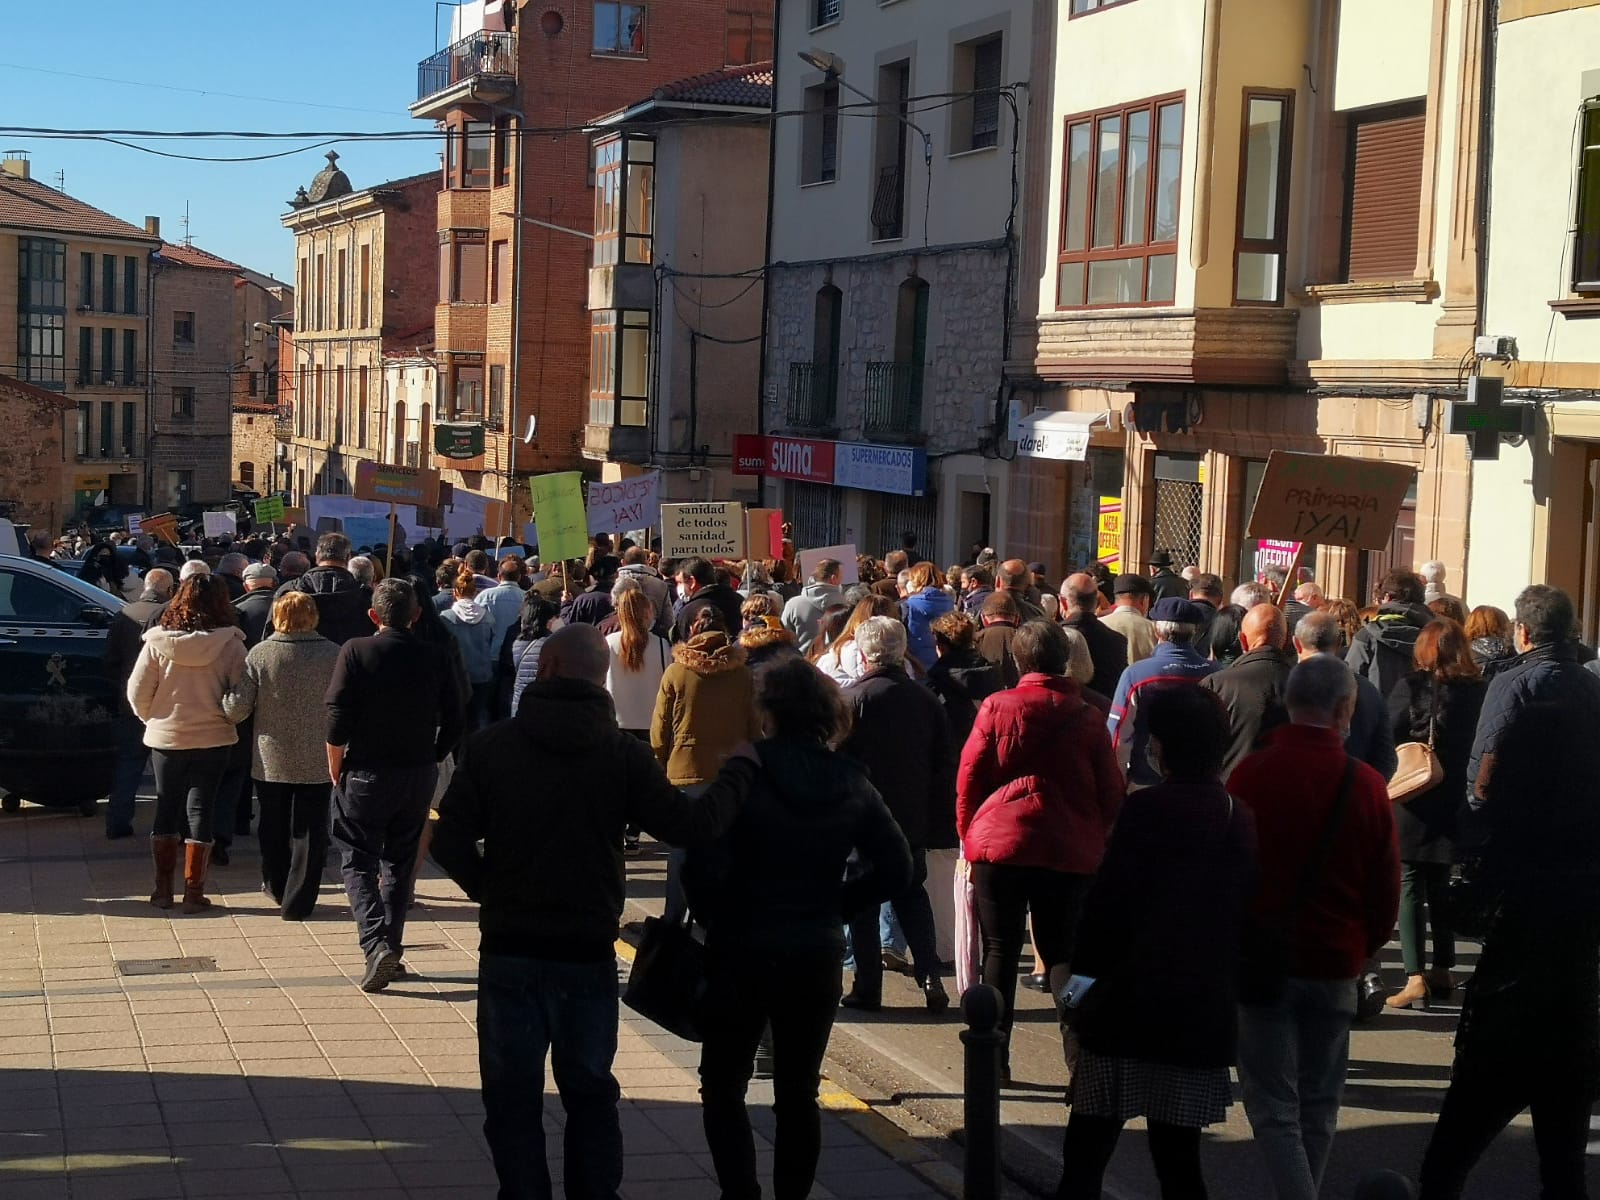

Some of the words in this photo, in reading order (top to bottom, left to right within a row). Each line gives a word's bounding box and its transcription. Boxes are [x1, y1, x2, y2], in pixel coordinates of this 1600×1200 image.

[1019, 433, 1046, 453] clarel
[738, 456, 765, 467] sum
[771, 441, 812, 476] suma
[851, 447, 912, 468] SUPERMERCADOS
[678, 503, 726, 515] sanidad
[676, 517, 692, 528] de
[694, 517, 729, 528] todos
[1103, 514, 1119, 532] MEGA
[1293, 511, 1362, 544] ¡YA!
[679, 530, 726, 541] sanidad
[671, 545, 699, 557] para
[701, 543, 736, 555] todos
